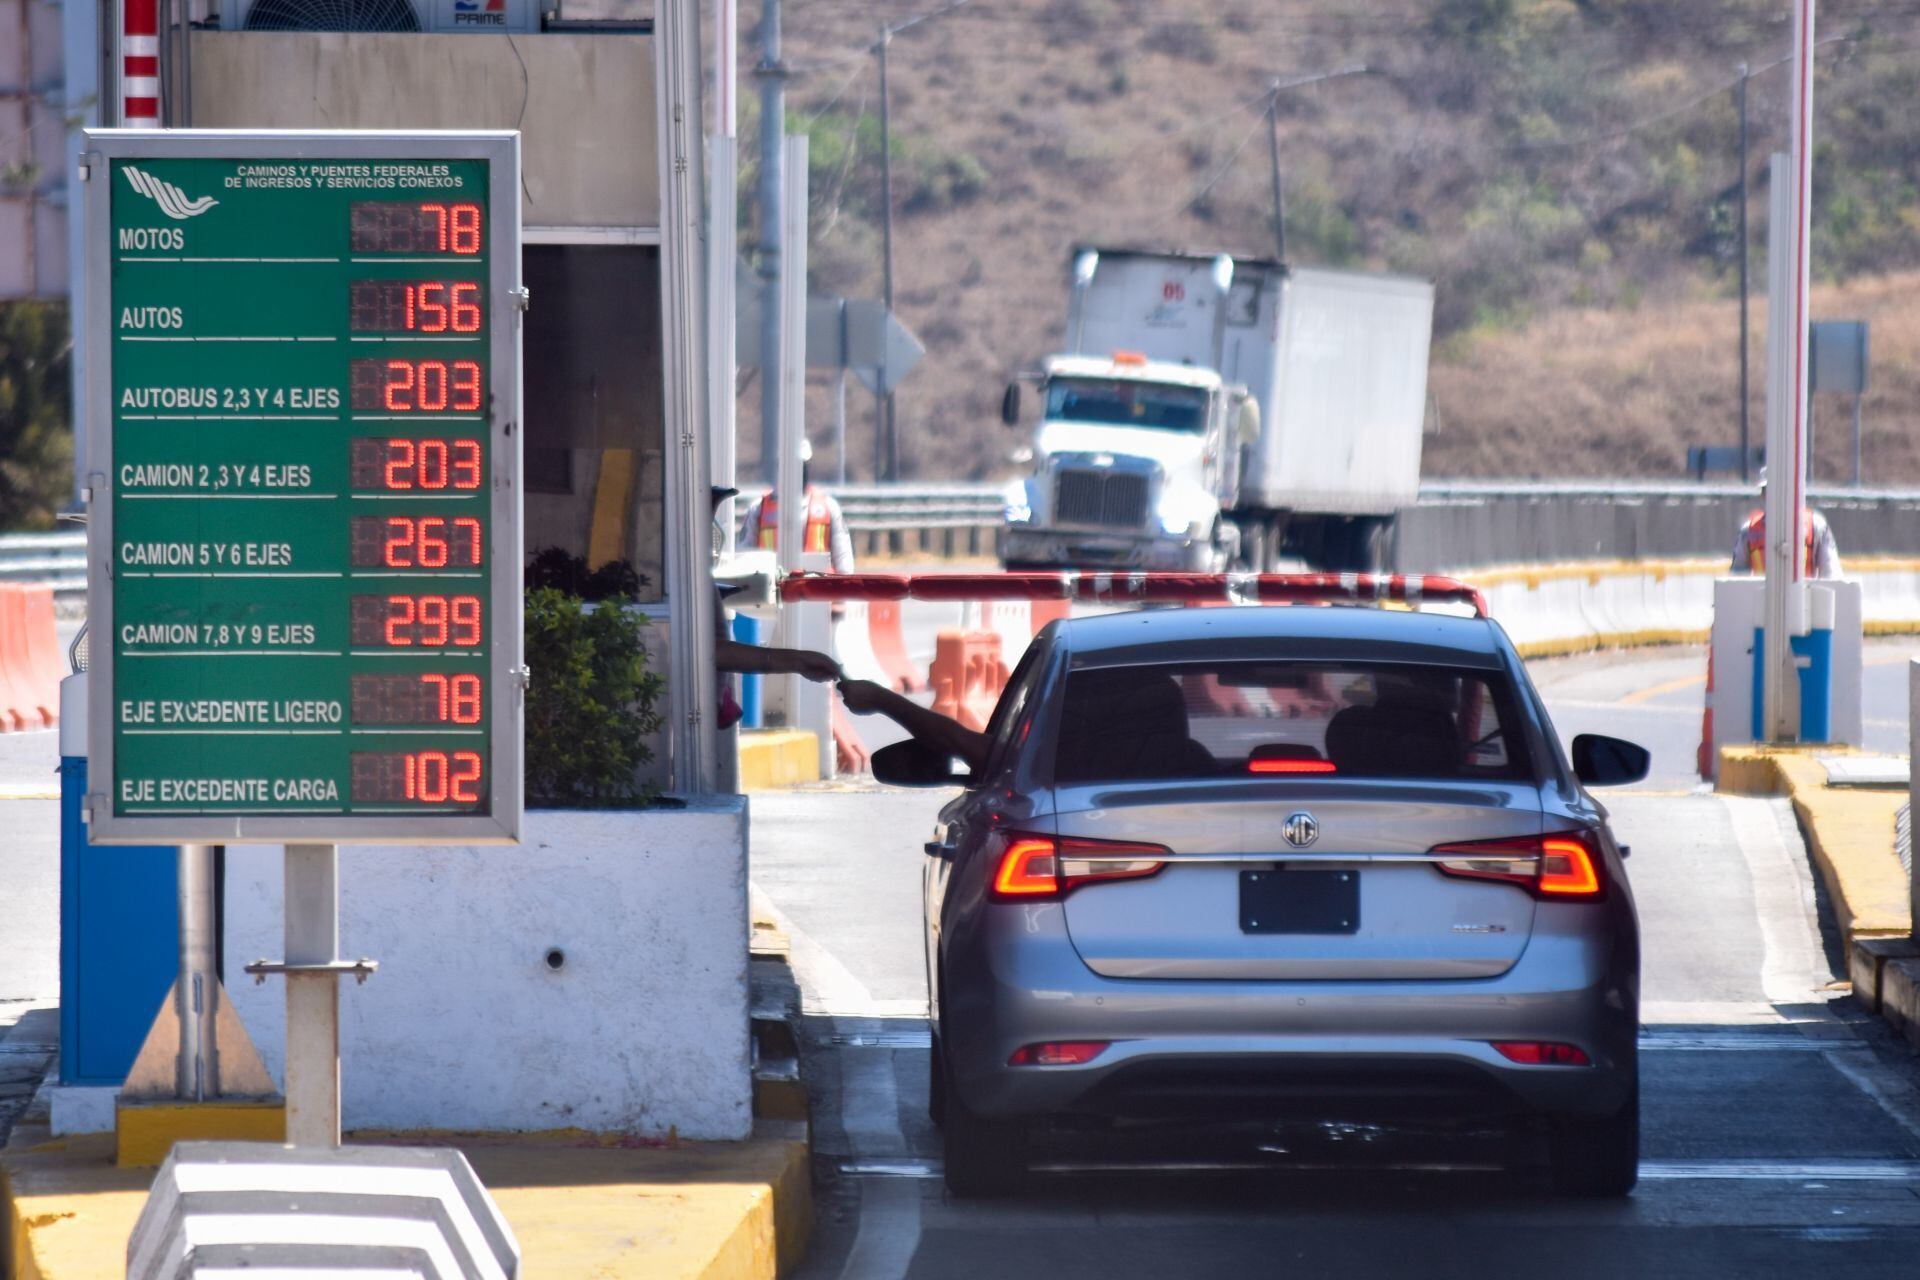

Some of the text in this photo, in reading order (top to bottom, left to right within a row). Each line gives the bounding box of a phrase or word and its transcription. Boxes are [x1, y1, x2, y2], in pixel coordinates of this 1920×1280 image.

[455, 13, 505, 25] PRIME
[225, 177, 463, 188] DE INGRESOS Y SERVICIOS CONEXOS
[238, 166, 450, 177] CAMINOS Y PUENTES FEDERALES
[119, 228, 184, 250] MOTOS
[421, 204, 480, 254] 78
[120, 307, 183, 329] AUTOS
[404, 282, 480, 332] 156
[385, 361, 480, 410] 203
[121, 388, 340, 411] AUTOBUS 2,3 Y 4 EJES
[385, 439, 480, 489] 203
[121, 465, 194, 487] CAMION
[233, 465, 246, 487] Y
[249, 465, 260, 487] 4
[265, 465, 311, 487] EJES
[385, 517, 481, 567] 267
[121, 543, 292, 565] CAMION 5 Y 6 EJES
[385, 596, 481, 646] 299
[121, 625, 315, 647] CAMION 7,8 Y 9 EJES
[421, 674, 481, 724] 78
[121, 701, 342, 723] EJE EXCEDENTE LIGERO
[403, 752, 481, 802] 102
[121, 779, 339, 802] EJE EXCEDENTE CARGA
[1284, 812, 1318, 846] MG
